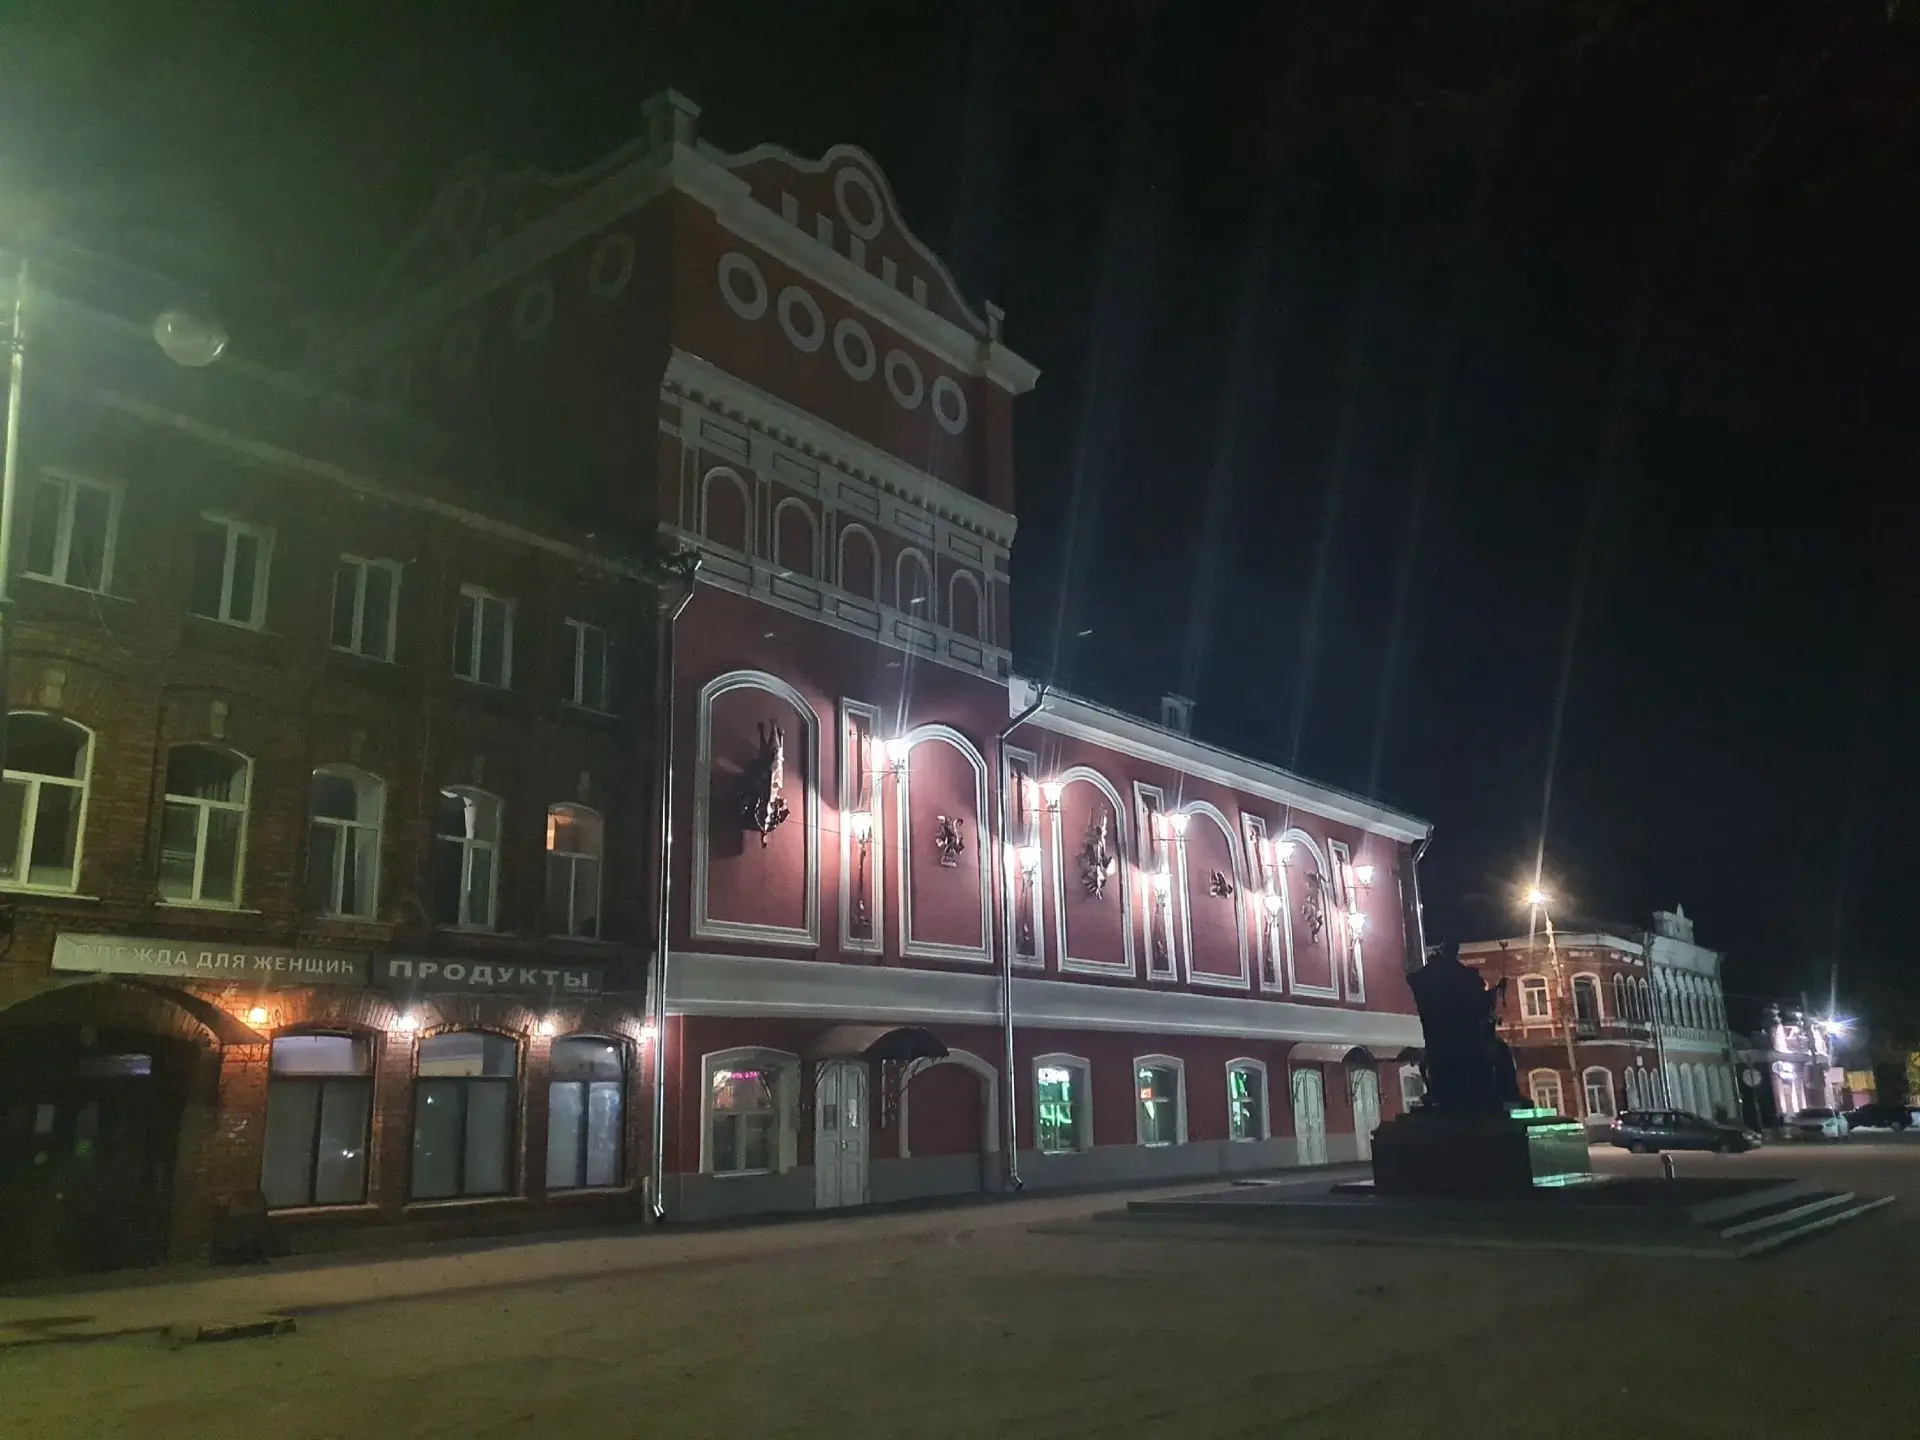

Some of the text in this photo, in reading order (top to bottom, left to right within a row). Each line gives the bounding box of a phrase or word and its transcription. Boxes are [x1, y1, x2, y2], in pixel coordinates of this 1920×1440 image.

[196, 951, 246, 970] ДЛЯ
[253, 955, 355, 976] ЖЕНЩИН
[388, 960, 589, 988] ПРОДУКТЫ
